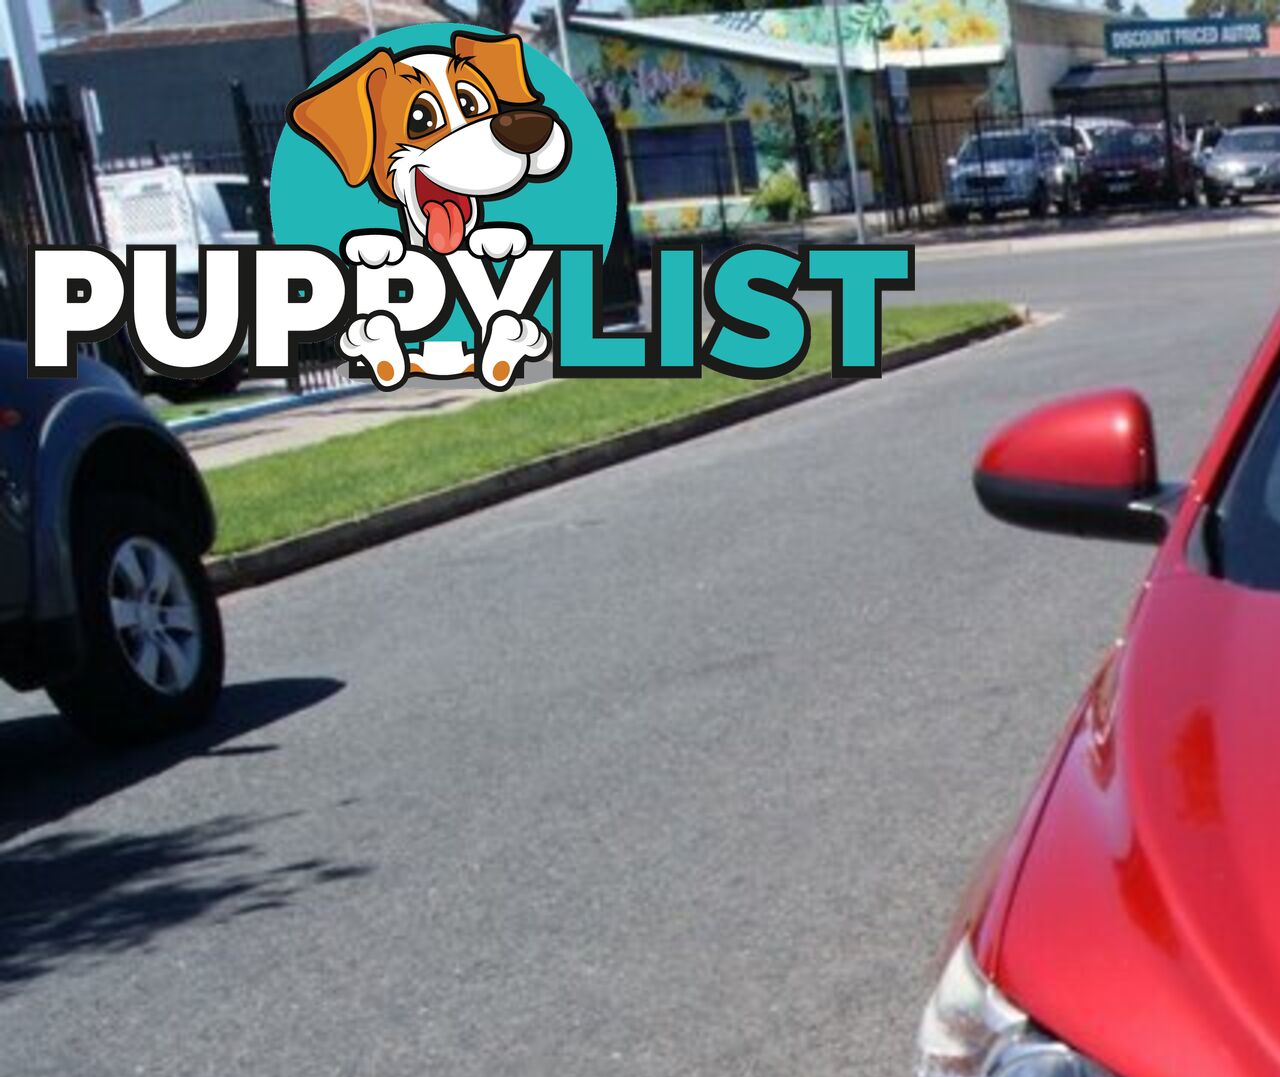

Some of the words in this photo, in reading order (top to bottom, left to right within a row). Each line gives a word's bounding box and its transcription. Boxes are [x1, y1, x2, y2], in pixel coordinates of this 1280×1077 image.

[1111, 28, 1172, 49] DISCOUNT
[1175, 26, 1219, 45] PRICED
[1220, 24, 1262, 43] AUTOS
